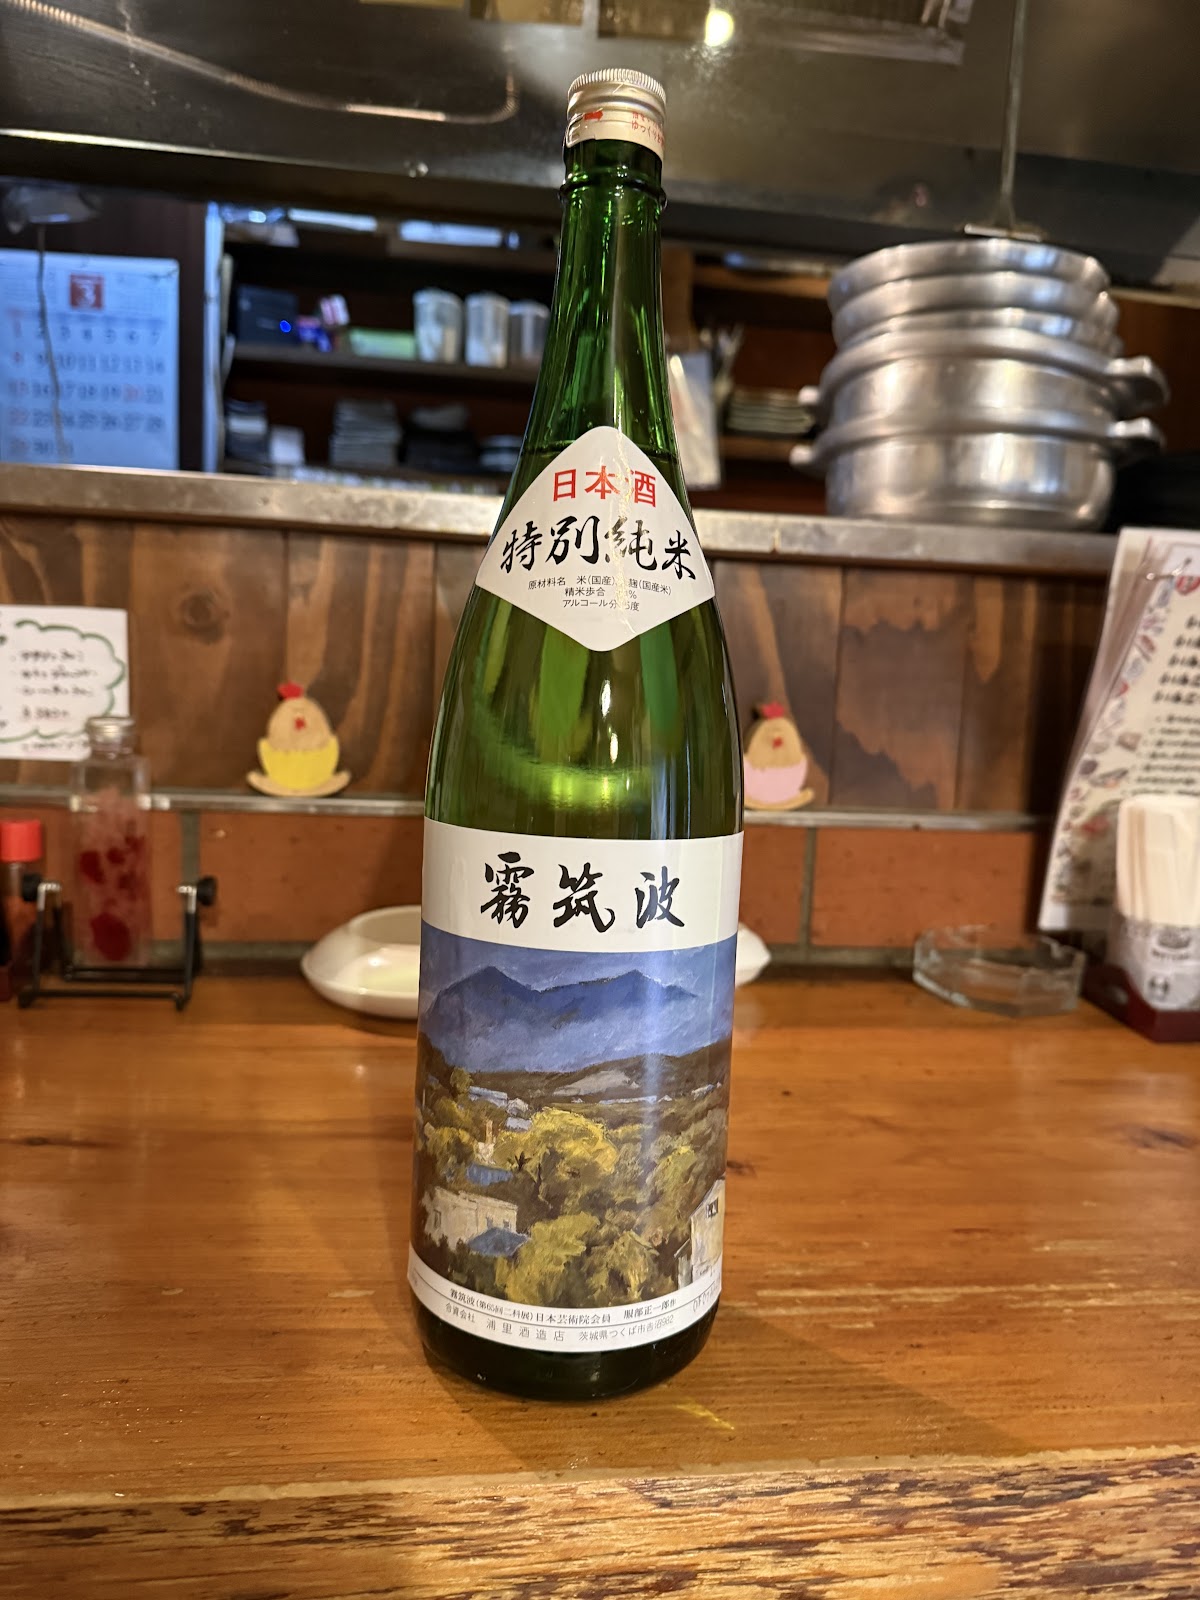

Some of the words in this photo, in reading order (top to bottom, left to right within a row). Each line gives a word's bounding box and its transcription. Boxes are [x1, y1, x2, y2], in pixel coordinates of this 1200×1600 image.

[553, 465, 657, 508] 日本酒
[500, 515, 697, 580] 特別純米
[528, 576, 566, 590] 原材料名
[565, 586, 606, 597] 精米歩合
[480, 851, 685, 933] 霧筑波
[486, 1318, 566, 1342] 浦里酒造店
